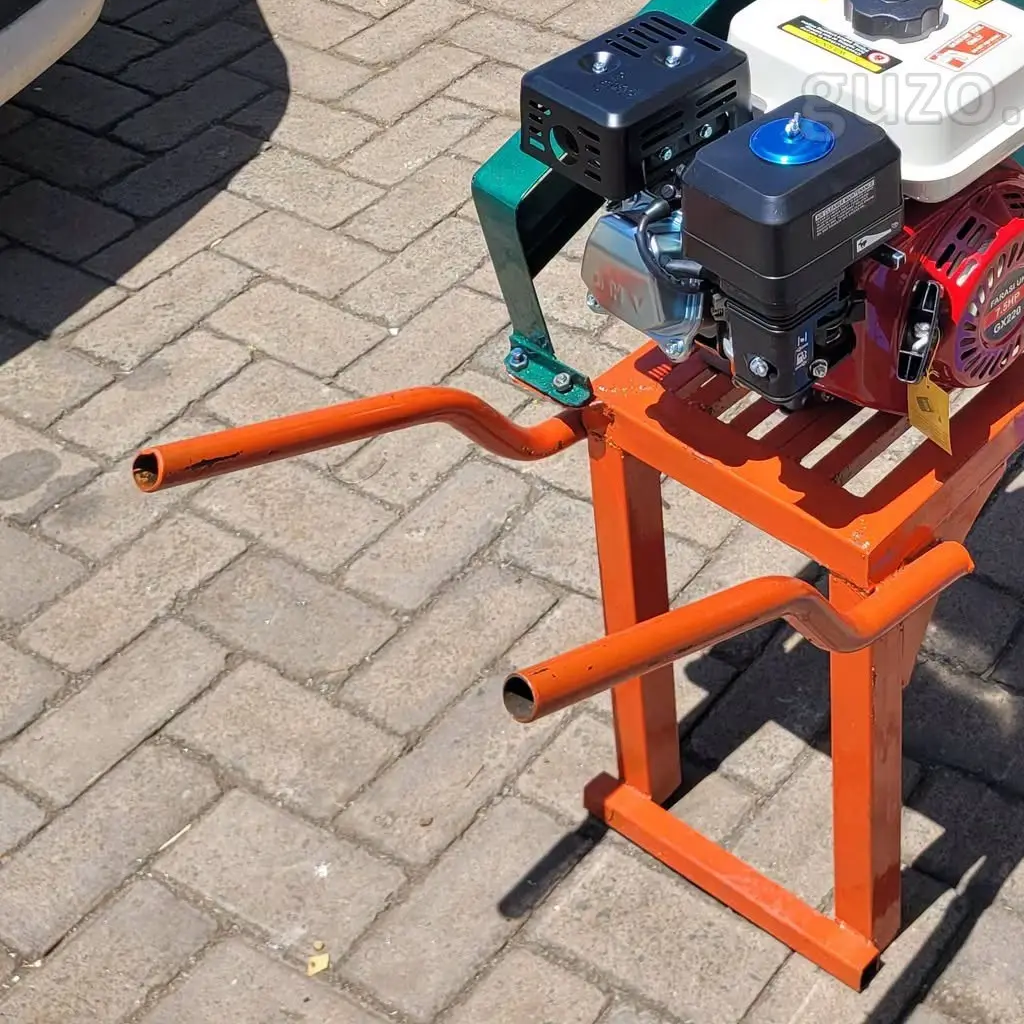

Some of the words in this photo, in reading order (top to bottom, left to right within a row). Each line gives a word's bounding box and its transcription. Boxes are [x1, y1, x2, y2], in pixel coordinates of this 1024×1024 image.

[990, 282, 1016, 309] FARASI
[996, 291, 1020, 318] 7.5HP
[993, 305, 1021, 334] GX220
